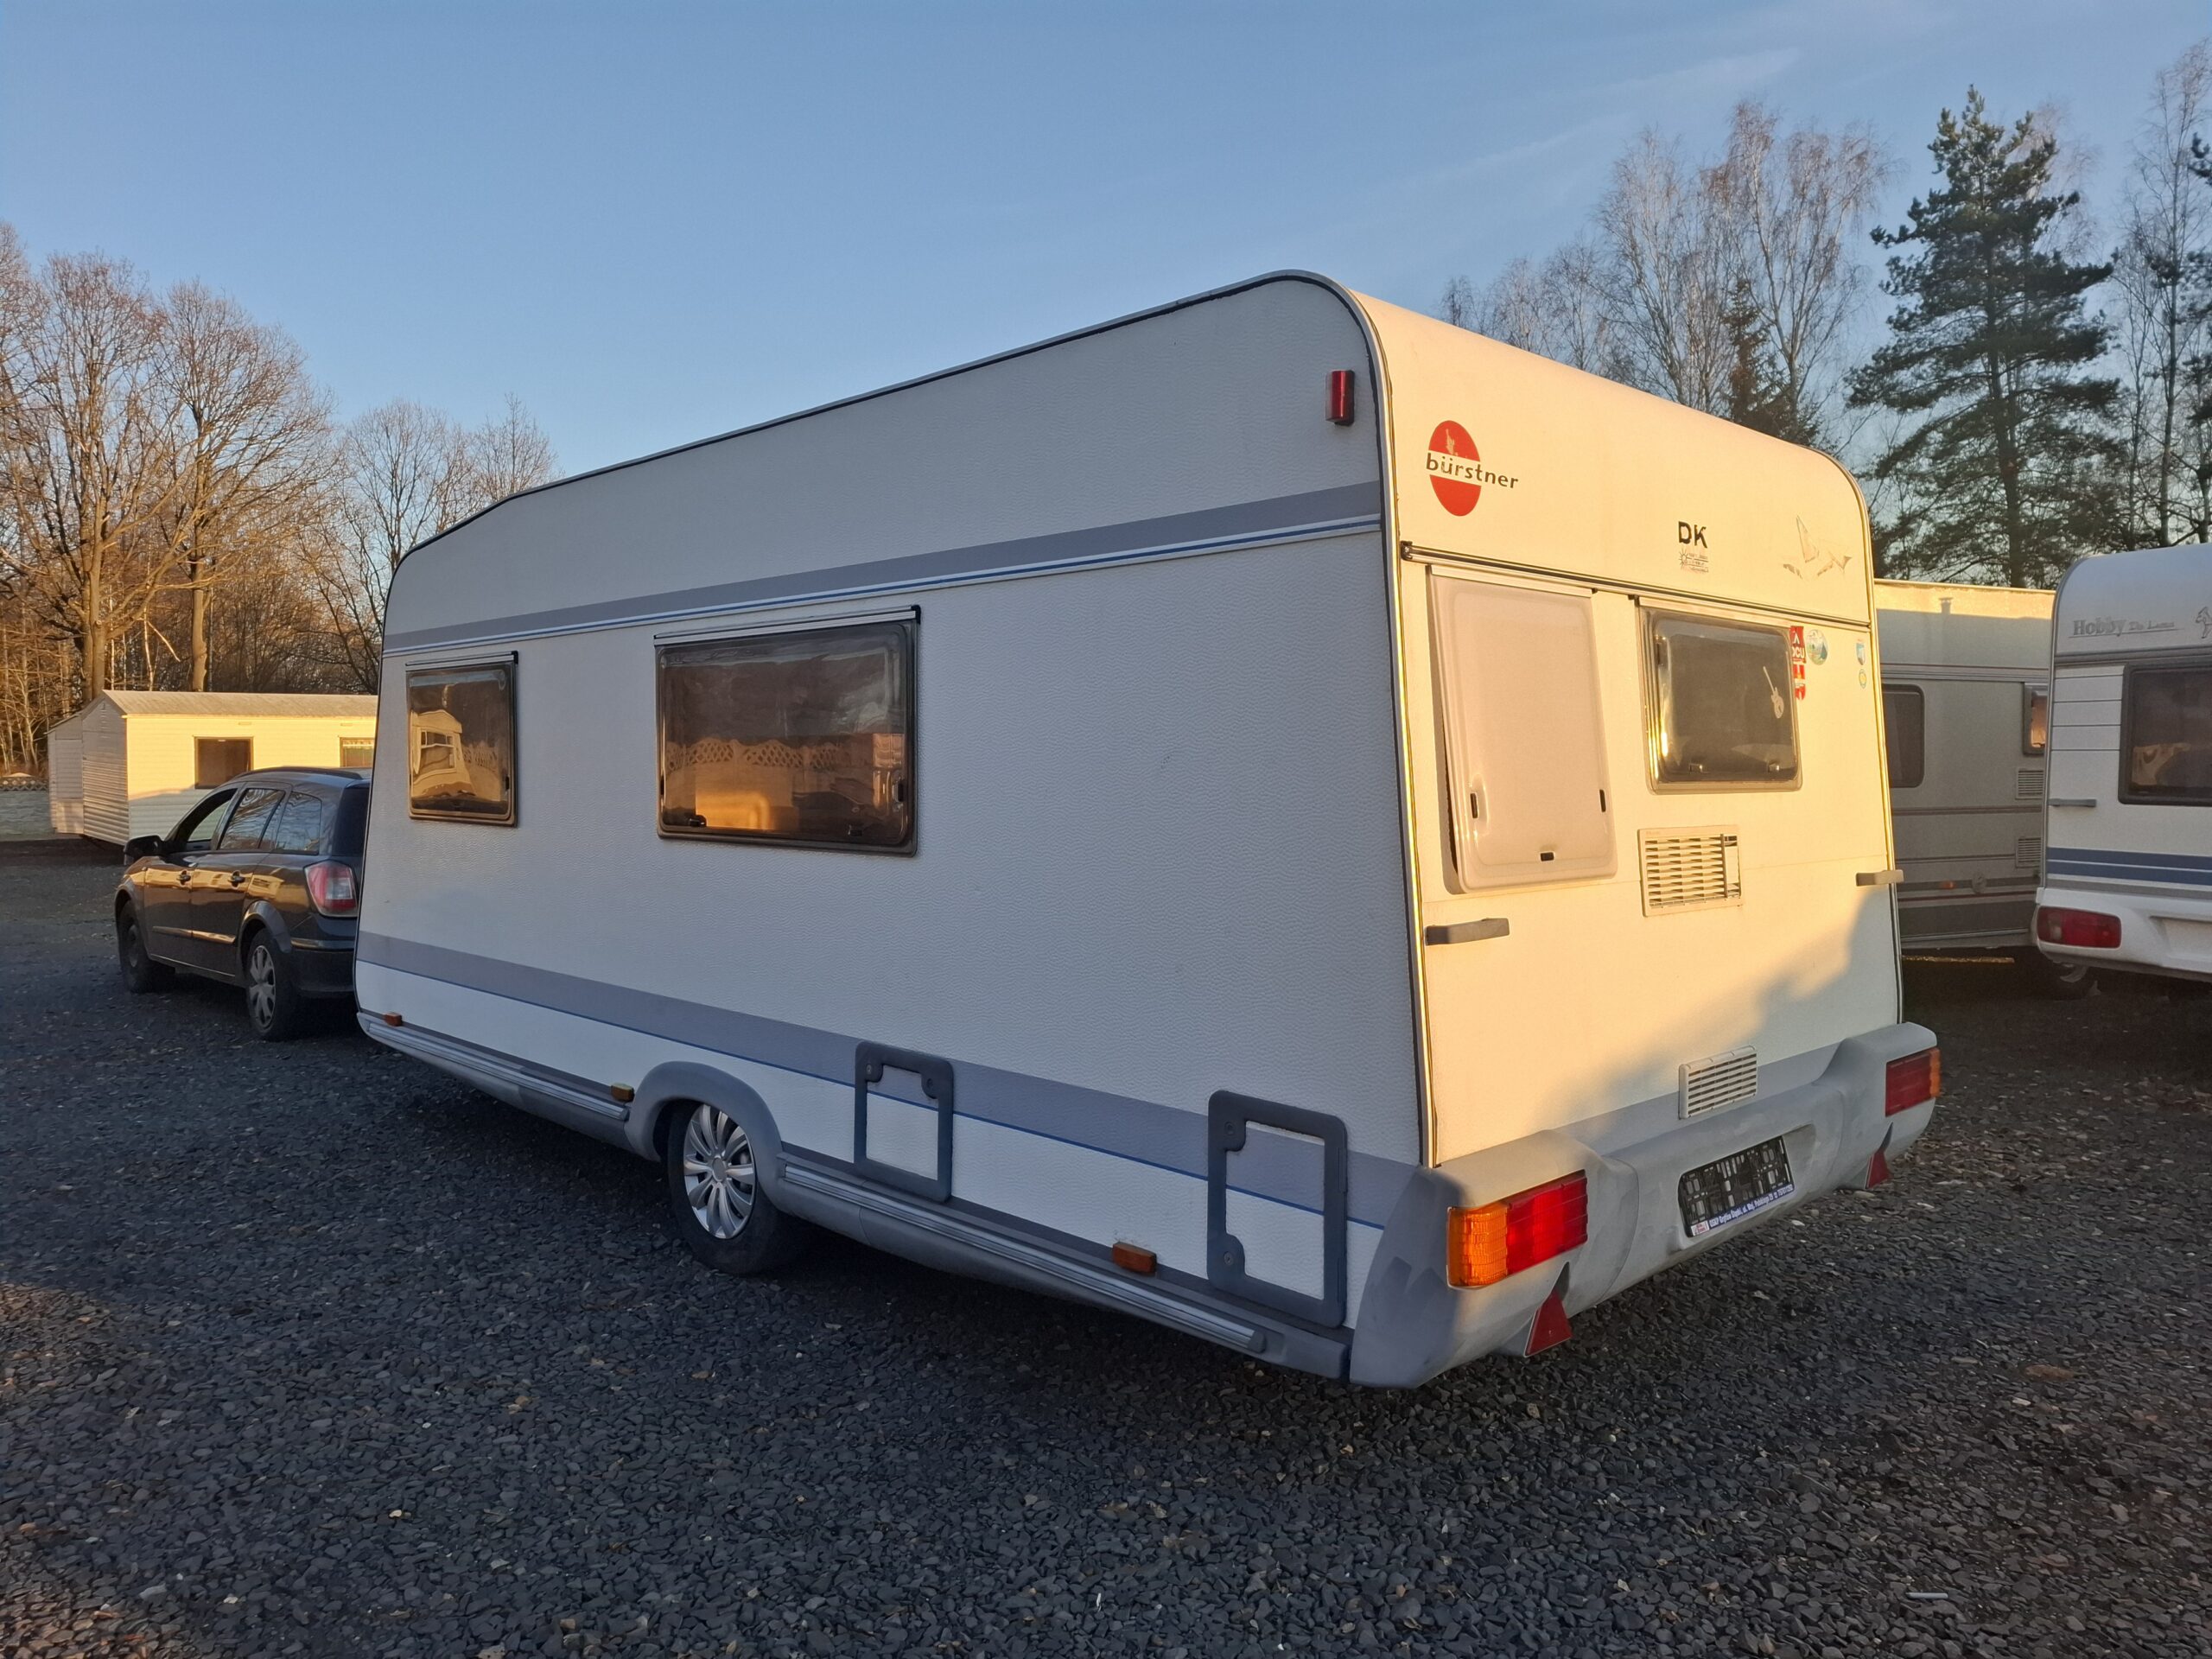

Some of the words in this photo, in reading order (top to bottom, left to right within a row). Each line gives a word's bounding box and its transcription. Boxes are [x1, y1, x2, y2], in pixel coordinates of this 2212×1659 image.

[1426, 452, 1518, 488] bürstner
[1678, 521, 1708, 549] DK
[2073, 616, 2126, 637] Hobby
